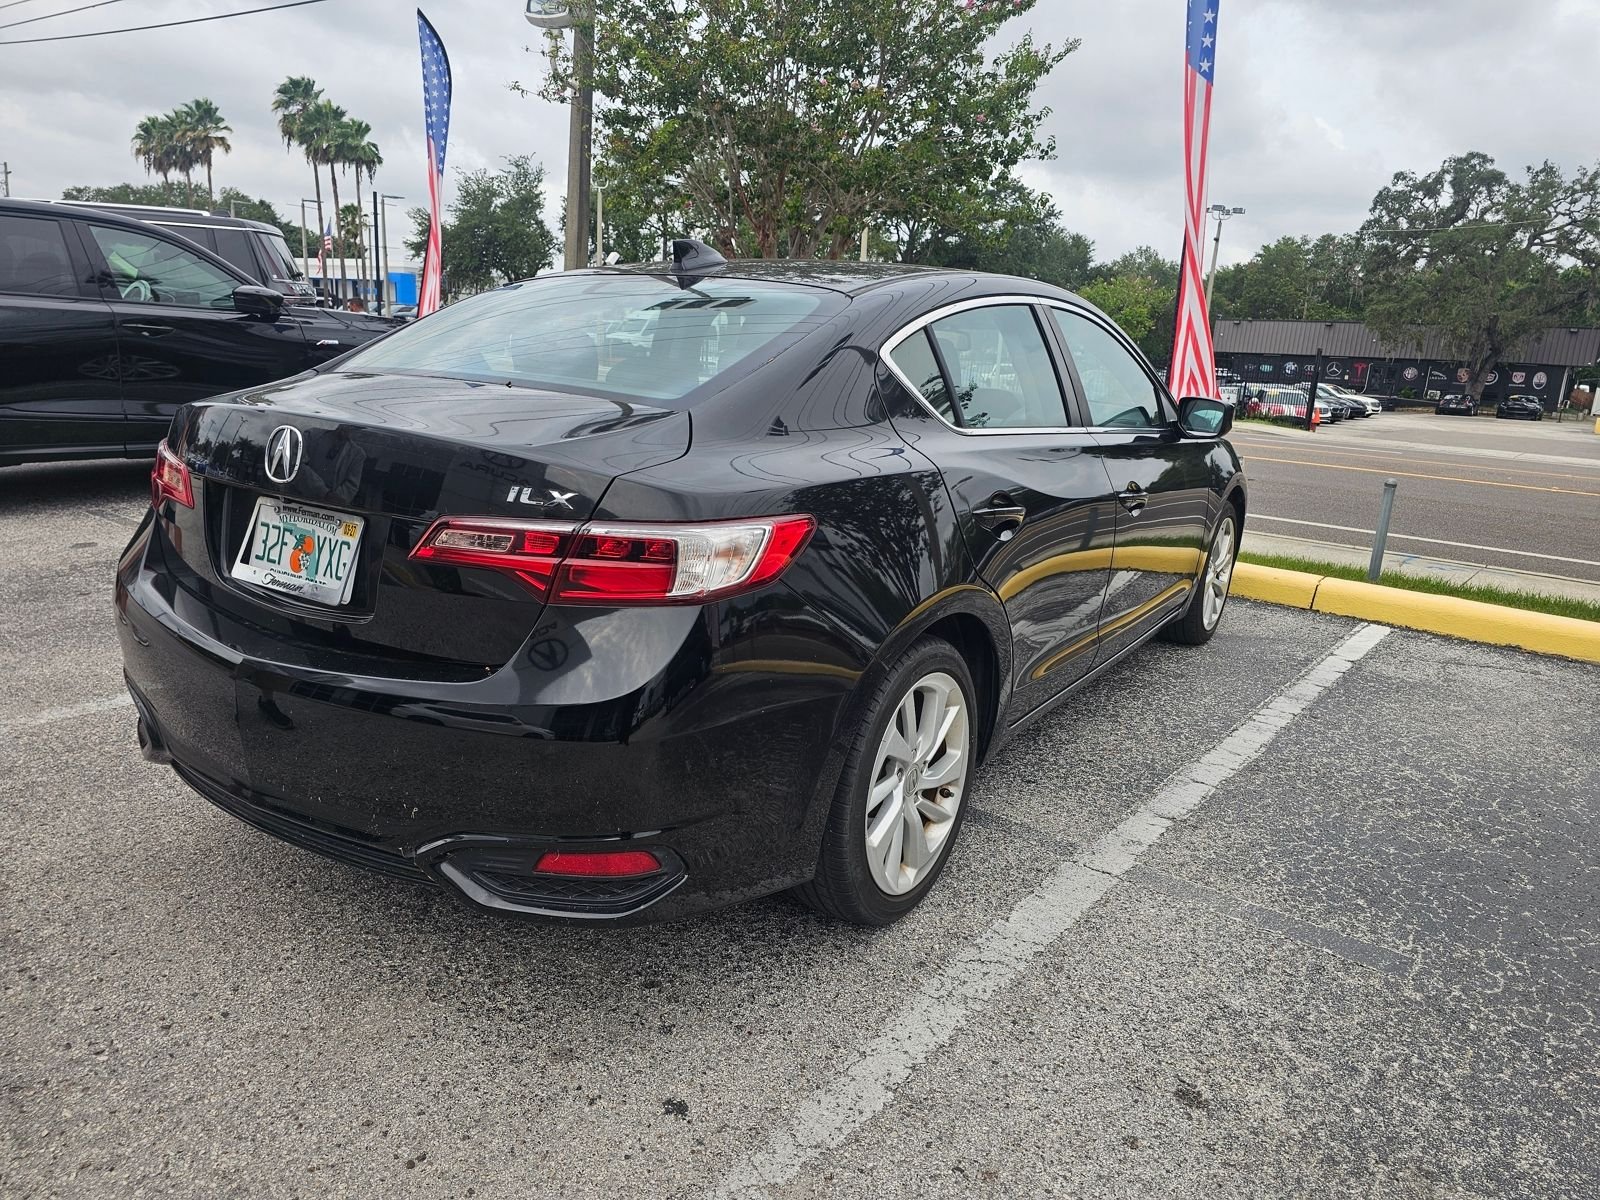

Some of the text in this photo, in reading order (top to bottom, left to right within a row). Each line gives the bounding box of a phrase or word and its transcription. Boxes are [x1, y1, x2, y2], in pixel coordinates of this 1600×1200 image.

[506, 485, 579, 510] ILX
[282, 504, 335, 522] www.Ferman.com
[254, 521, 351, 582] 32F YXG
[261, 572, 304, 594] Ferman
